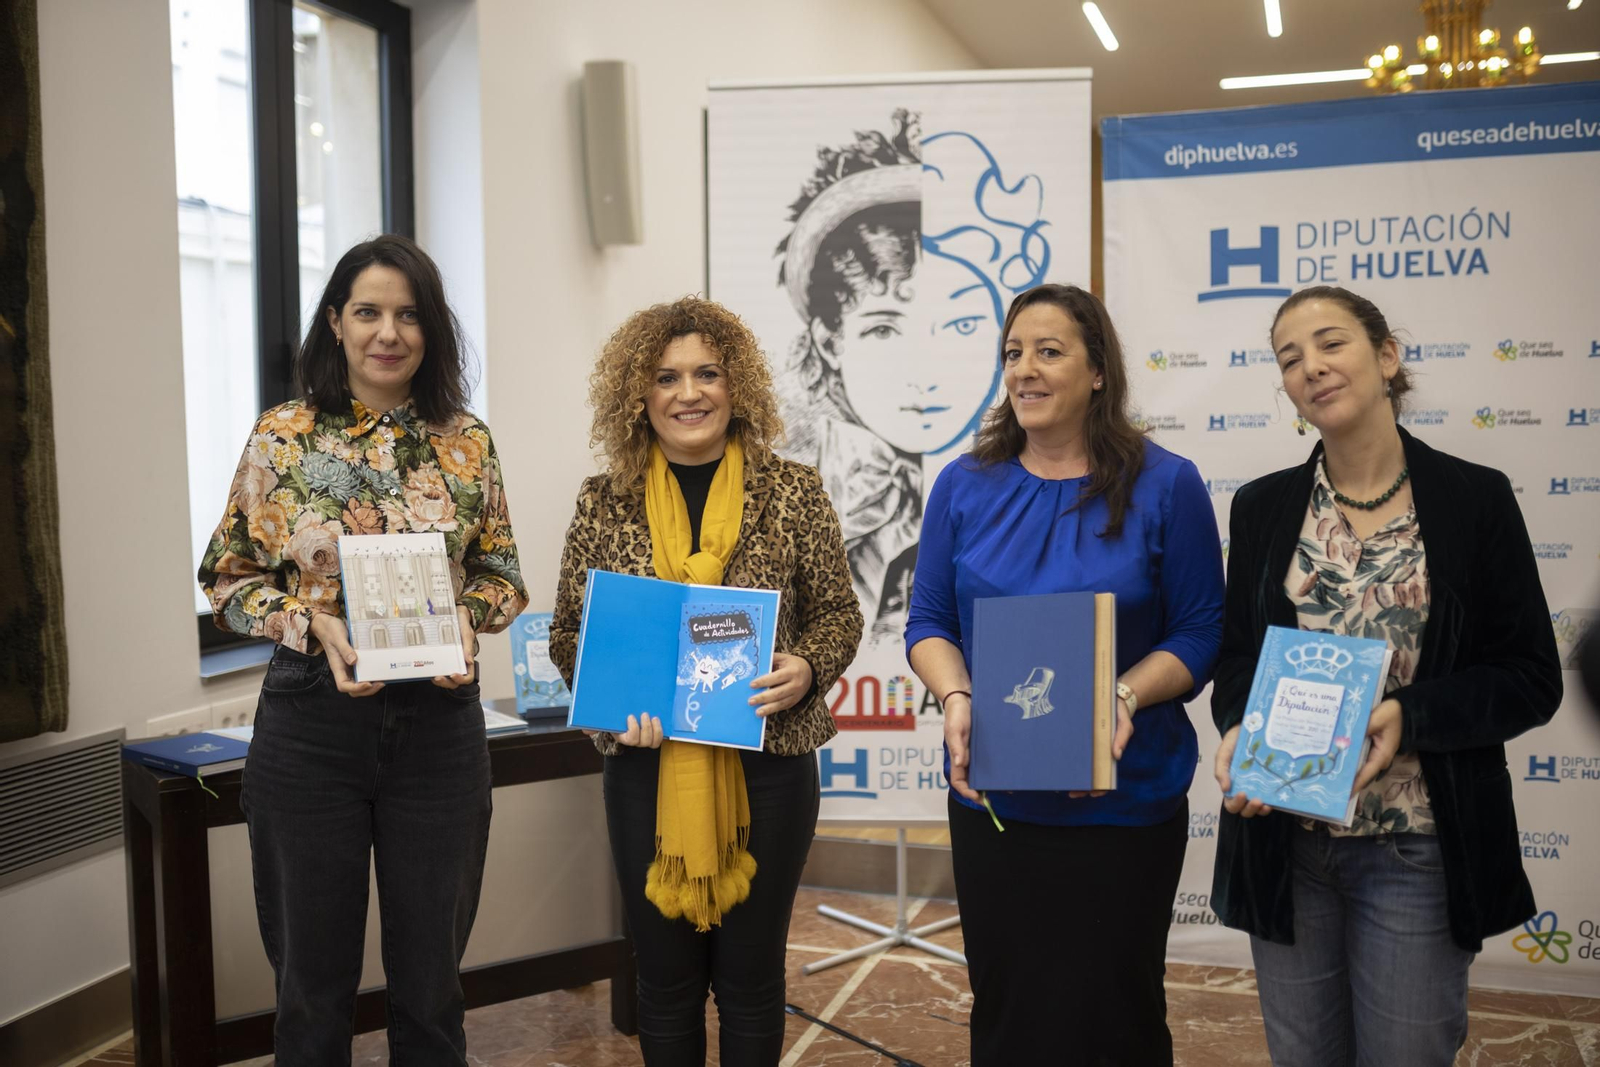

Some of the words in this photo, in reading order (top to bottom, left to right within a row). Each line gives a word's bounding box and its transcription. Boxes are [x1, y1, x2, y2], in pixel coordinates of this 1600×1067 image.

[1417, 118, 1600, 153] queseadehuelv
[1164, 141, 1298, 170] diphuelva.es
[1297, 207, 1511, 250] DIPUTACIÓN
[1297, 255, 1338, 284] DE
[1351, 248, 1490, 281] HUELVA
[692, 617, 736, 632] Cuadernillo
[711, 626, 750, 638] Actividades
[1309, 692, 1319, 700] es
[880, 771, 909, 790] DE
[1561, 768, 1578, 780] DE
[1177, 892, 1209, 908] sea
